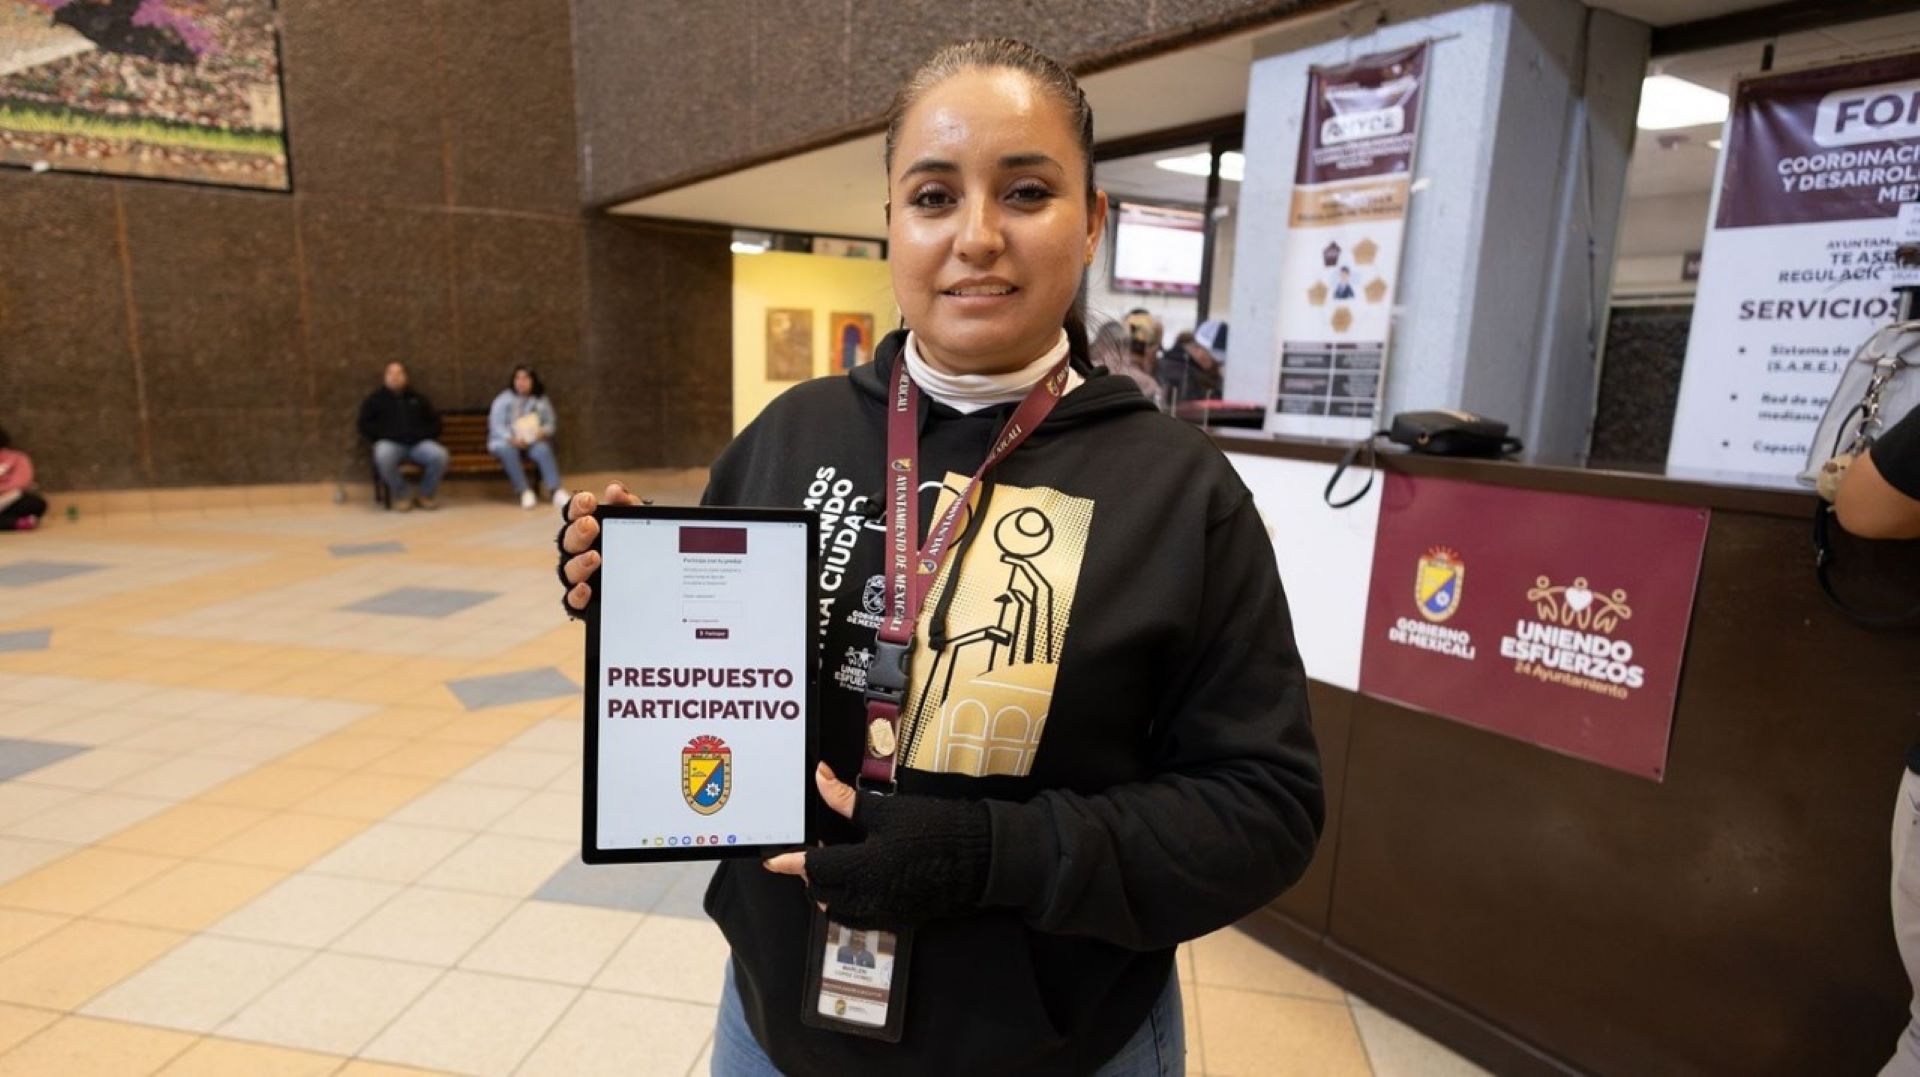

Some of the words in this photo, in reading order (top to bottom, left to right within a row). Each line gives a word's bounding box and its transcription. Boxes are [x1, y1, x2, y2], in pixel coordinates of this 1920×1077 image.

[1782, 177, 1796, 193] Y
[1799, 163, 1920, 191] DESARROL
[1827, 237, 1896, 250] AYUNTAM
[1831, 251, 1852, 265] TE
[1857, 250, 1896, 265] ASE
[1770, 344, 1829, 356] Sistema
[1832, 345, 1850, 356] de
[1791, 393, 1807, 404] de
[1811, 396, 1829, 407] ap
[1752, 440, 1806, 454] Capacit
[803, 466, 836, 511] MOS
[894, 475, 909, 552] AYUNTAMIENTO
[894, 554, 907, 570] DE
[890, 572, 908, 631] MEXICALI
[1389, 627, 1407, 645] DE
[1408, 632, 1476, 660] MEXICALI
[1396, 616, 1470, 645] GOBIERNO
[1516, 619, 1633, 663] UNIENDO
[1500, 636, 1645, 688] ESFUERZOS
[608, 667, 793, 688] PRESUPUESTO
[1515, 661, 1532, 674] 24
[1532, 663, 1628, 700] Ayuntamiento
[608, 699, 800, 720] PARTICIPATIVO
